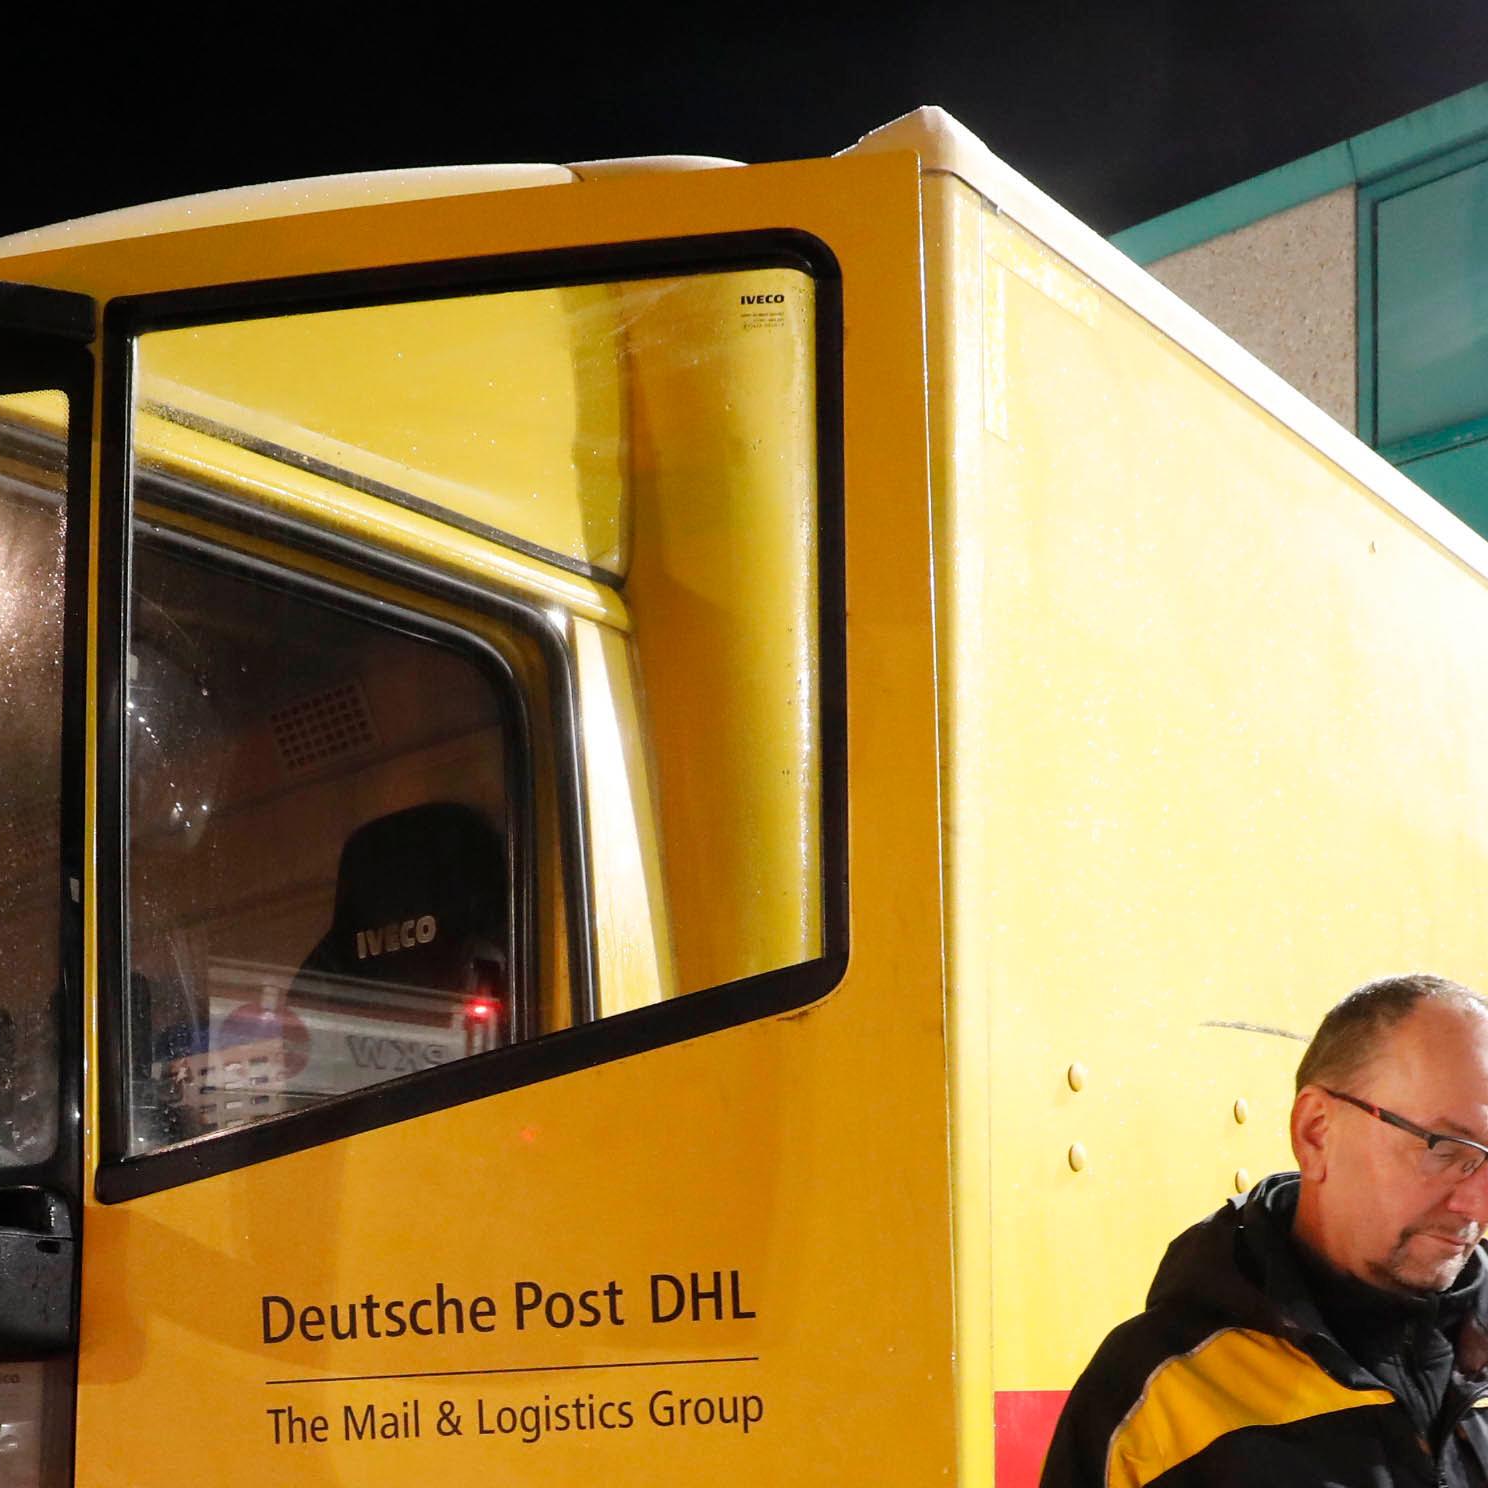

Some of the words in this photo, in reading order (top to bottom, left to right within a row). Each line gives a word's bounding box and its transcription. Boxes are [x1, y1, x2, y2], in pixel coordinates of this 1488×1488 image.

[740, 294, 785, 305] IVECO
[356, 915, 438, 959] IVECO
[261, 1282, 497, 1344] Deutsche
[514, 1280, 625, 1330] Post
[650, 1270, 757, 1323] DHL
[267, 1407, 330, 1444] The
[344, 1400, 420, 1441] Mail
[436, 1399, 463, 1436] &
[478, 1394, 634, 1443] Logistics
[648, 1390, 765, 1433] Group
